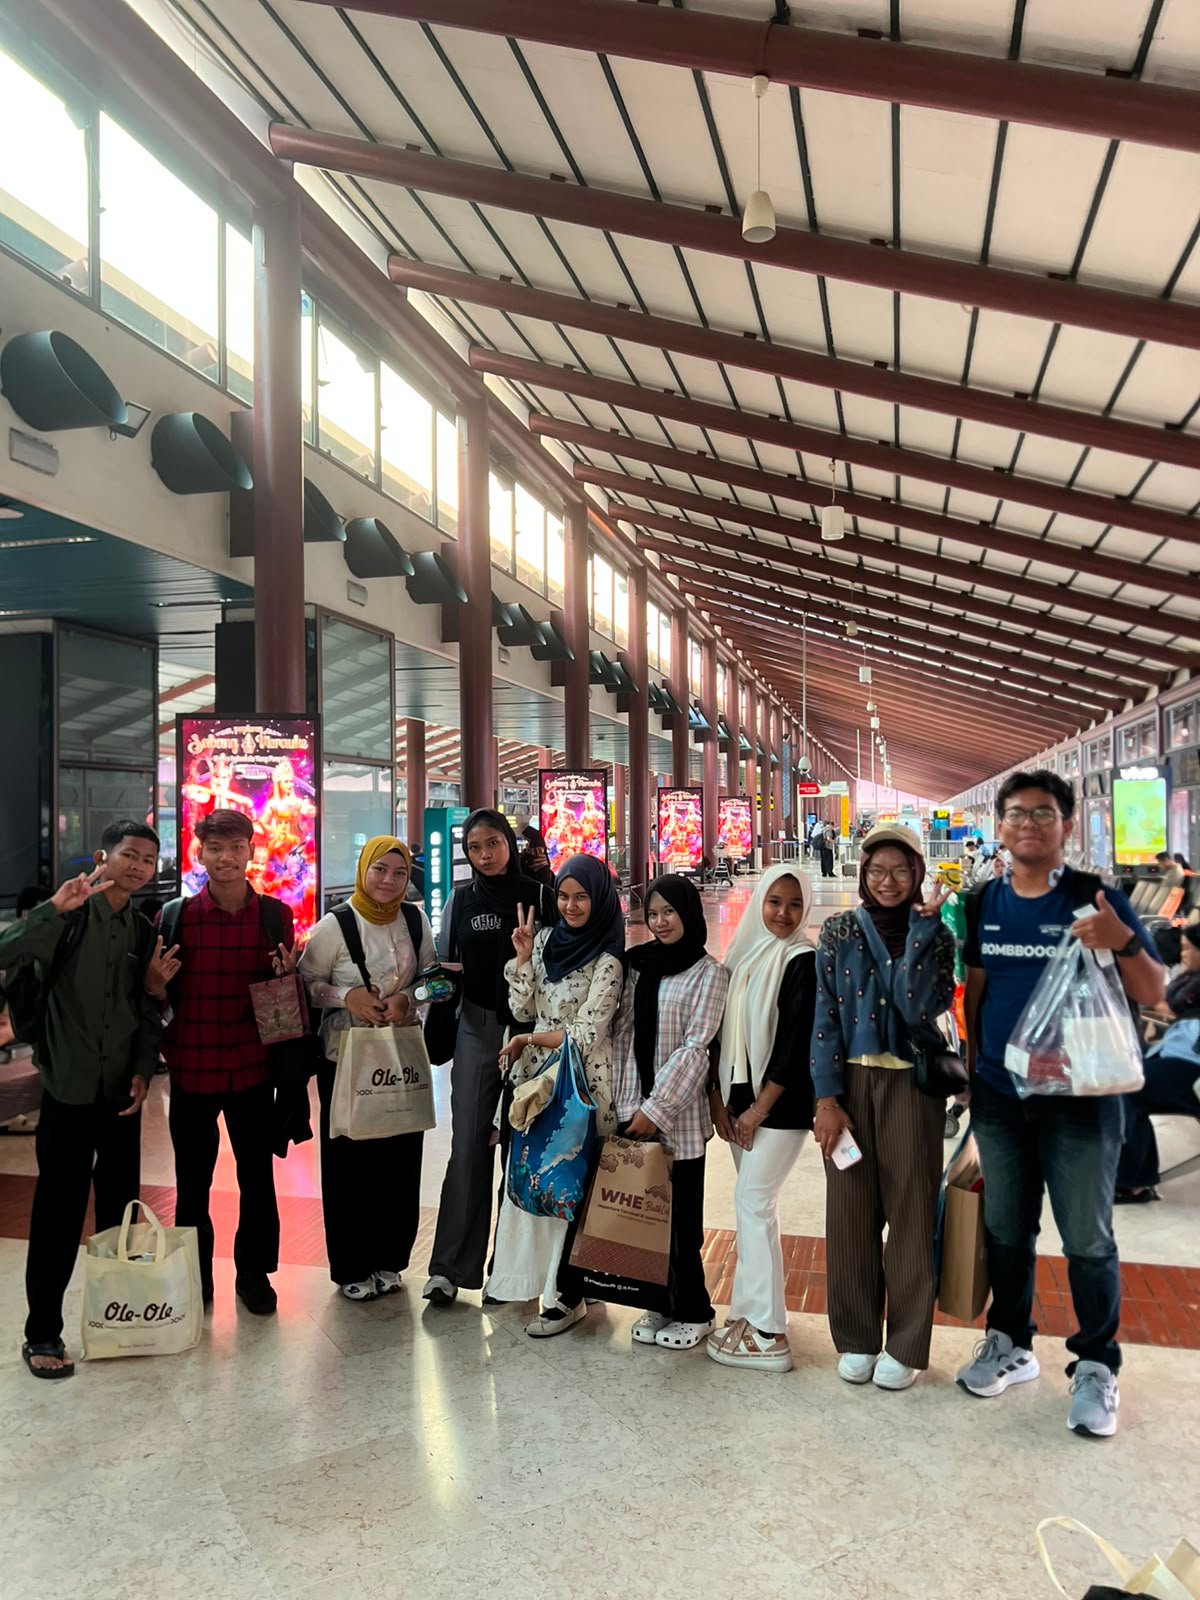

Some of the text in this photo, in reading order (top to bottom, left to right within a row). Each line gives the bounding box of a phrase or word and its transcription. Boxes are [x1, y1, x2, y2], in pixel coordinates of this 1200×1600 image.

[430, 888, 441, 937] CHARG
[371, 1066, 420, 1087] Ole-Ole
[601, 1188, 645, 1210] WHE
[104, 1301, 173, 1322] Ole-Ole
